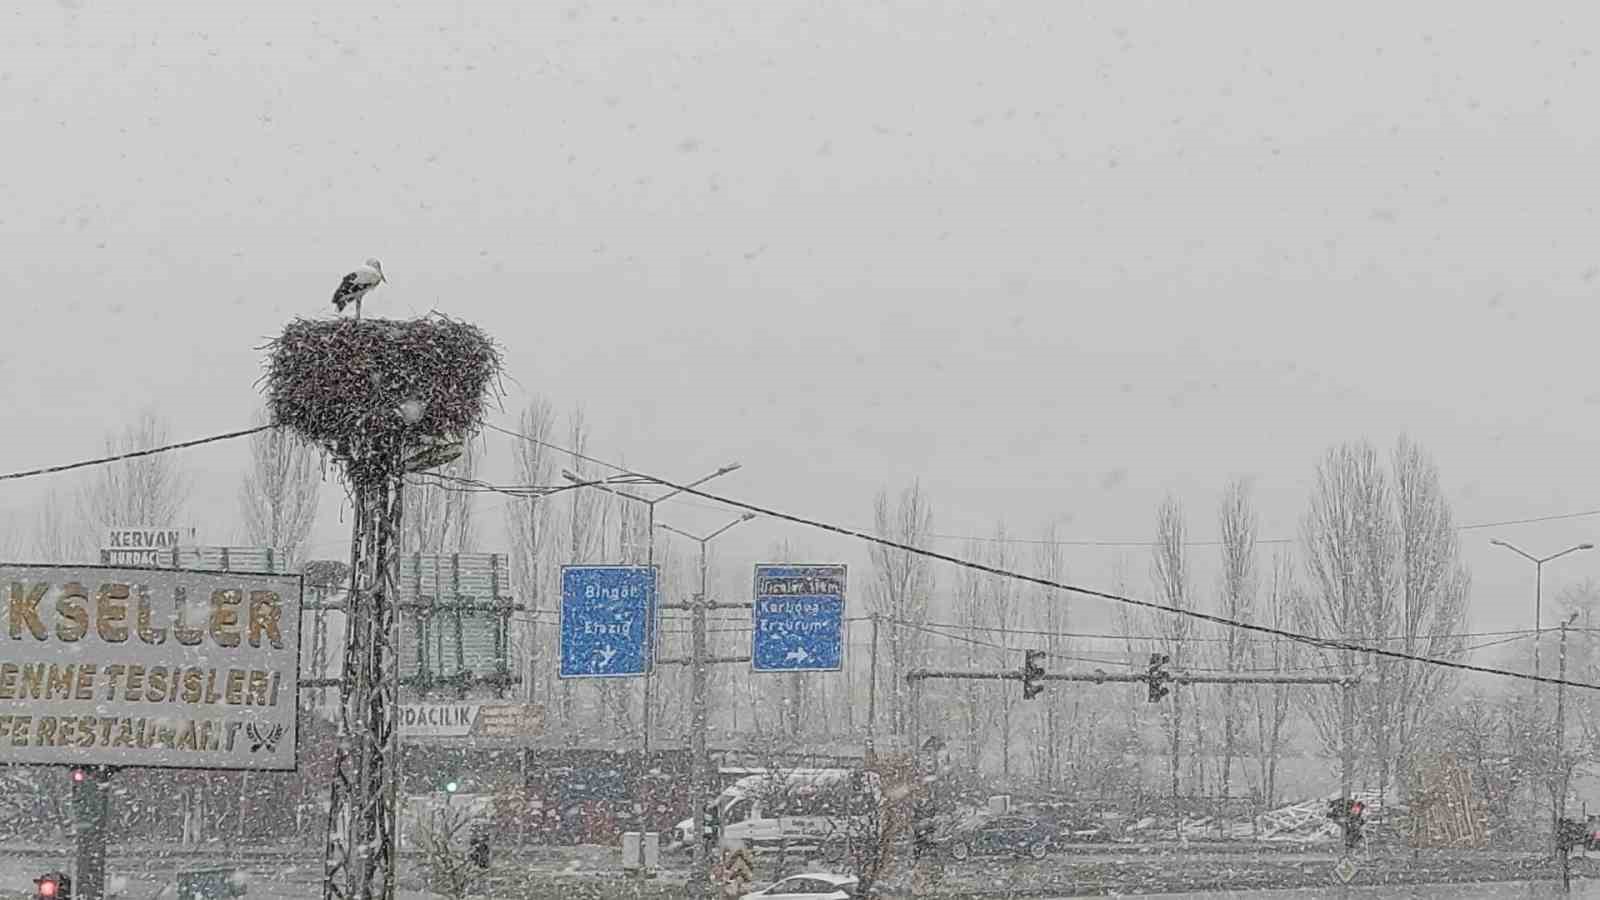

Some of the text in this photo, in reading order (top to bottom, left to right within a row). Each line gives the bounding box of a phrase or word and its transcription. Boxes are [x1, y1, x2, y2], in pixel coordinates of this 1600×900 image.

[110, 531, 179, 548] KERVAN
[8, 581, 284, 650] KSELLER
[0, 663, 97, 700] ENME
